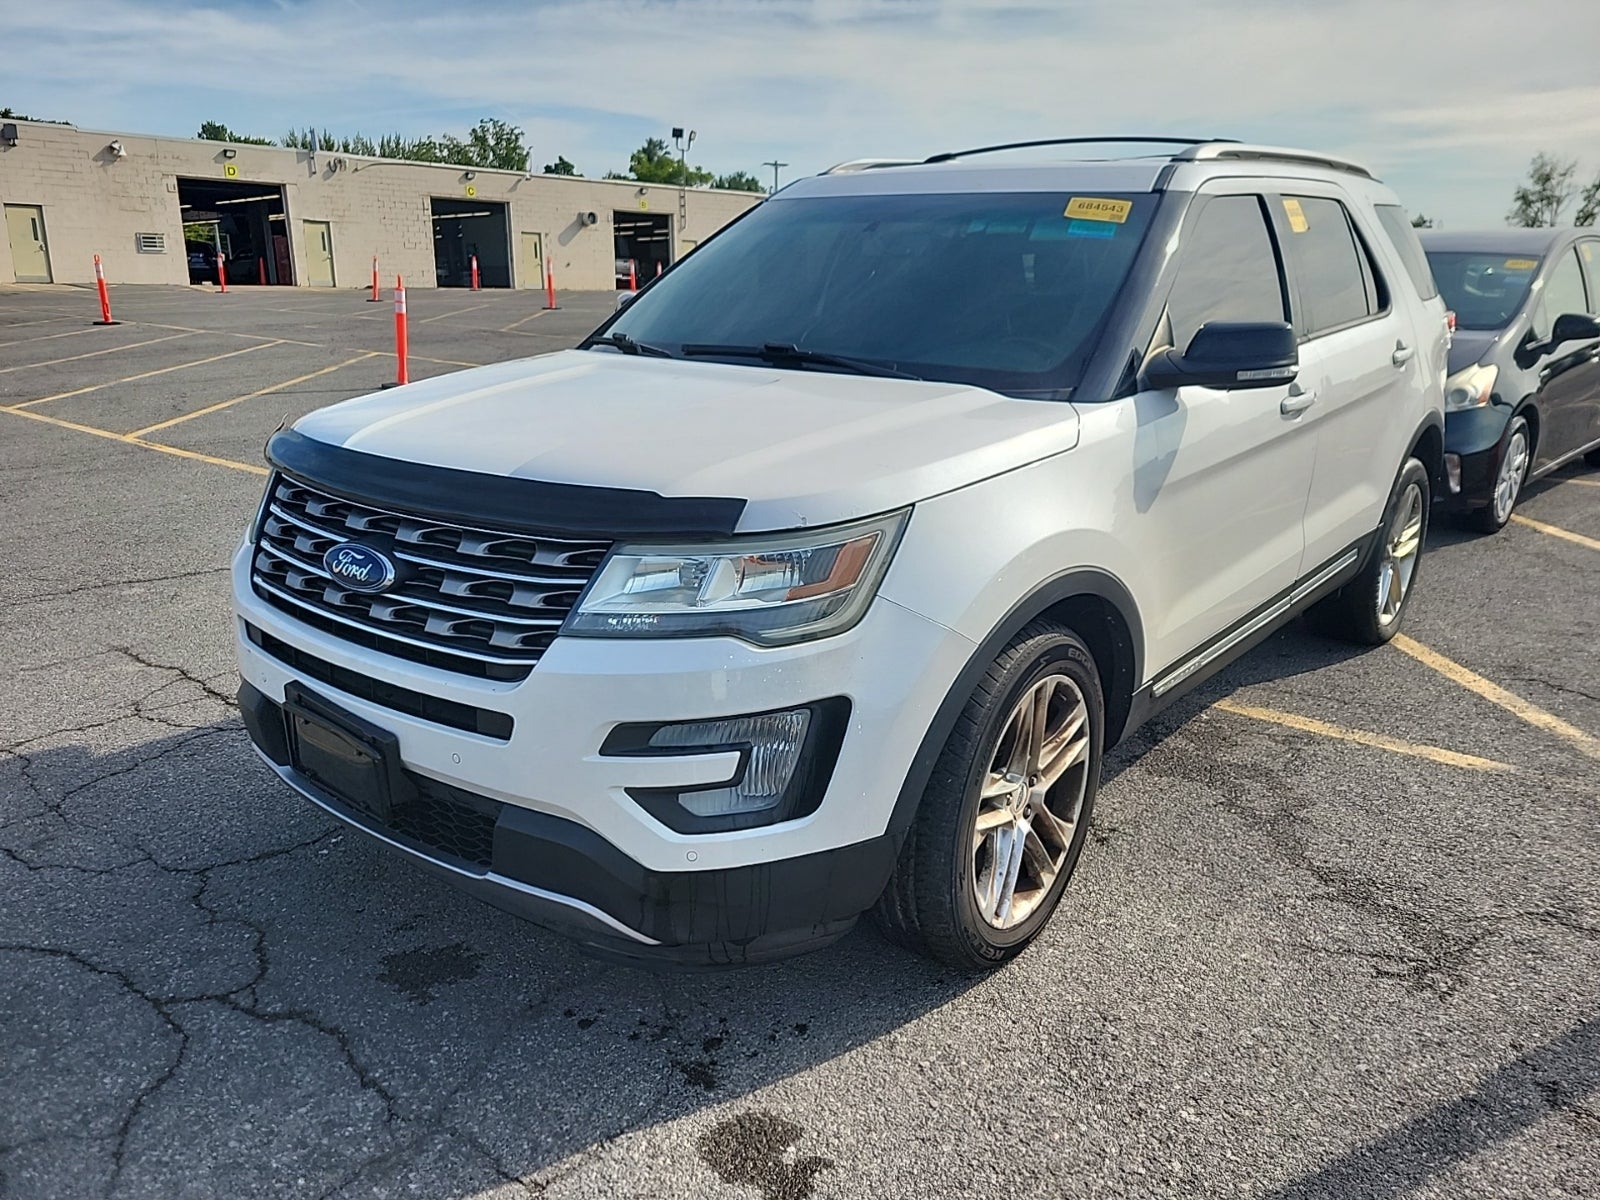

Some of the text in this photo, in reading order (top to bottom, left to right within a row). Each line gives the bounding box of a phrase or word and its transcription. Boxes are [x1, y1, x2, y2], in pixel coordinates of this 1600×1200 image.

[227, 166, 236, 176] D
[467, 186, 475, 196] C
[1077, 201, 1125, 213] 684543
[332, 549, 373, 581] Ford
